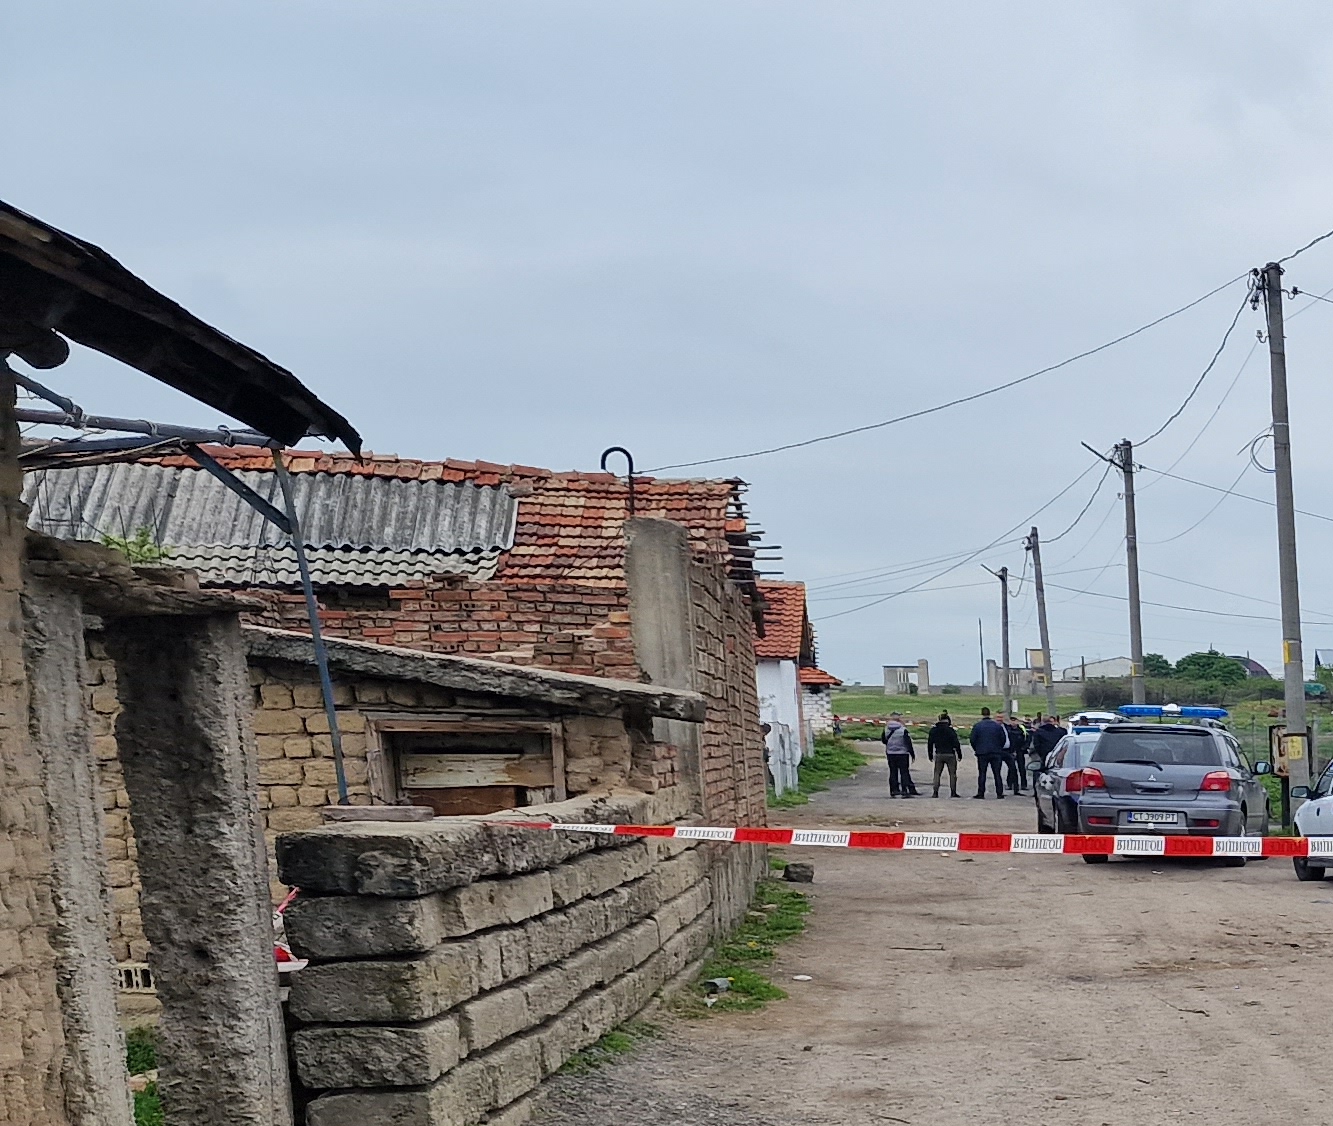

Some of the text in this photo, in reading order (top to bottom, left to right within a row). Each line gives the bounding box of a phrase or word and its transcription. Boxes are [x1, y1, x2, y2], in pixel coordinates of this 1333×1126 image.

[677, 830, 733, 839] ПОЛИЦИЯ
[794, 832, 848, 844] ПОЛИЦИЯ
[906, 834, 957, 848] ПОЛИЦИЯ
[1013, 837, 1062, 850] ПОЛИЦИЯ
[1117, 838, 1163, 851] ПОЛИЦИЯ
[1215, 840, 1260, 852] ПОЛИЦИЯ
